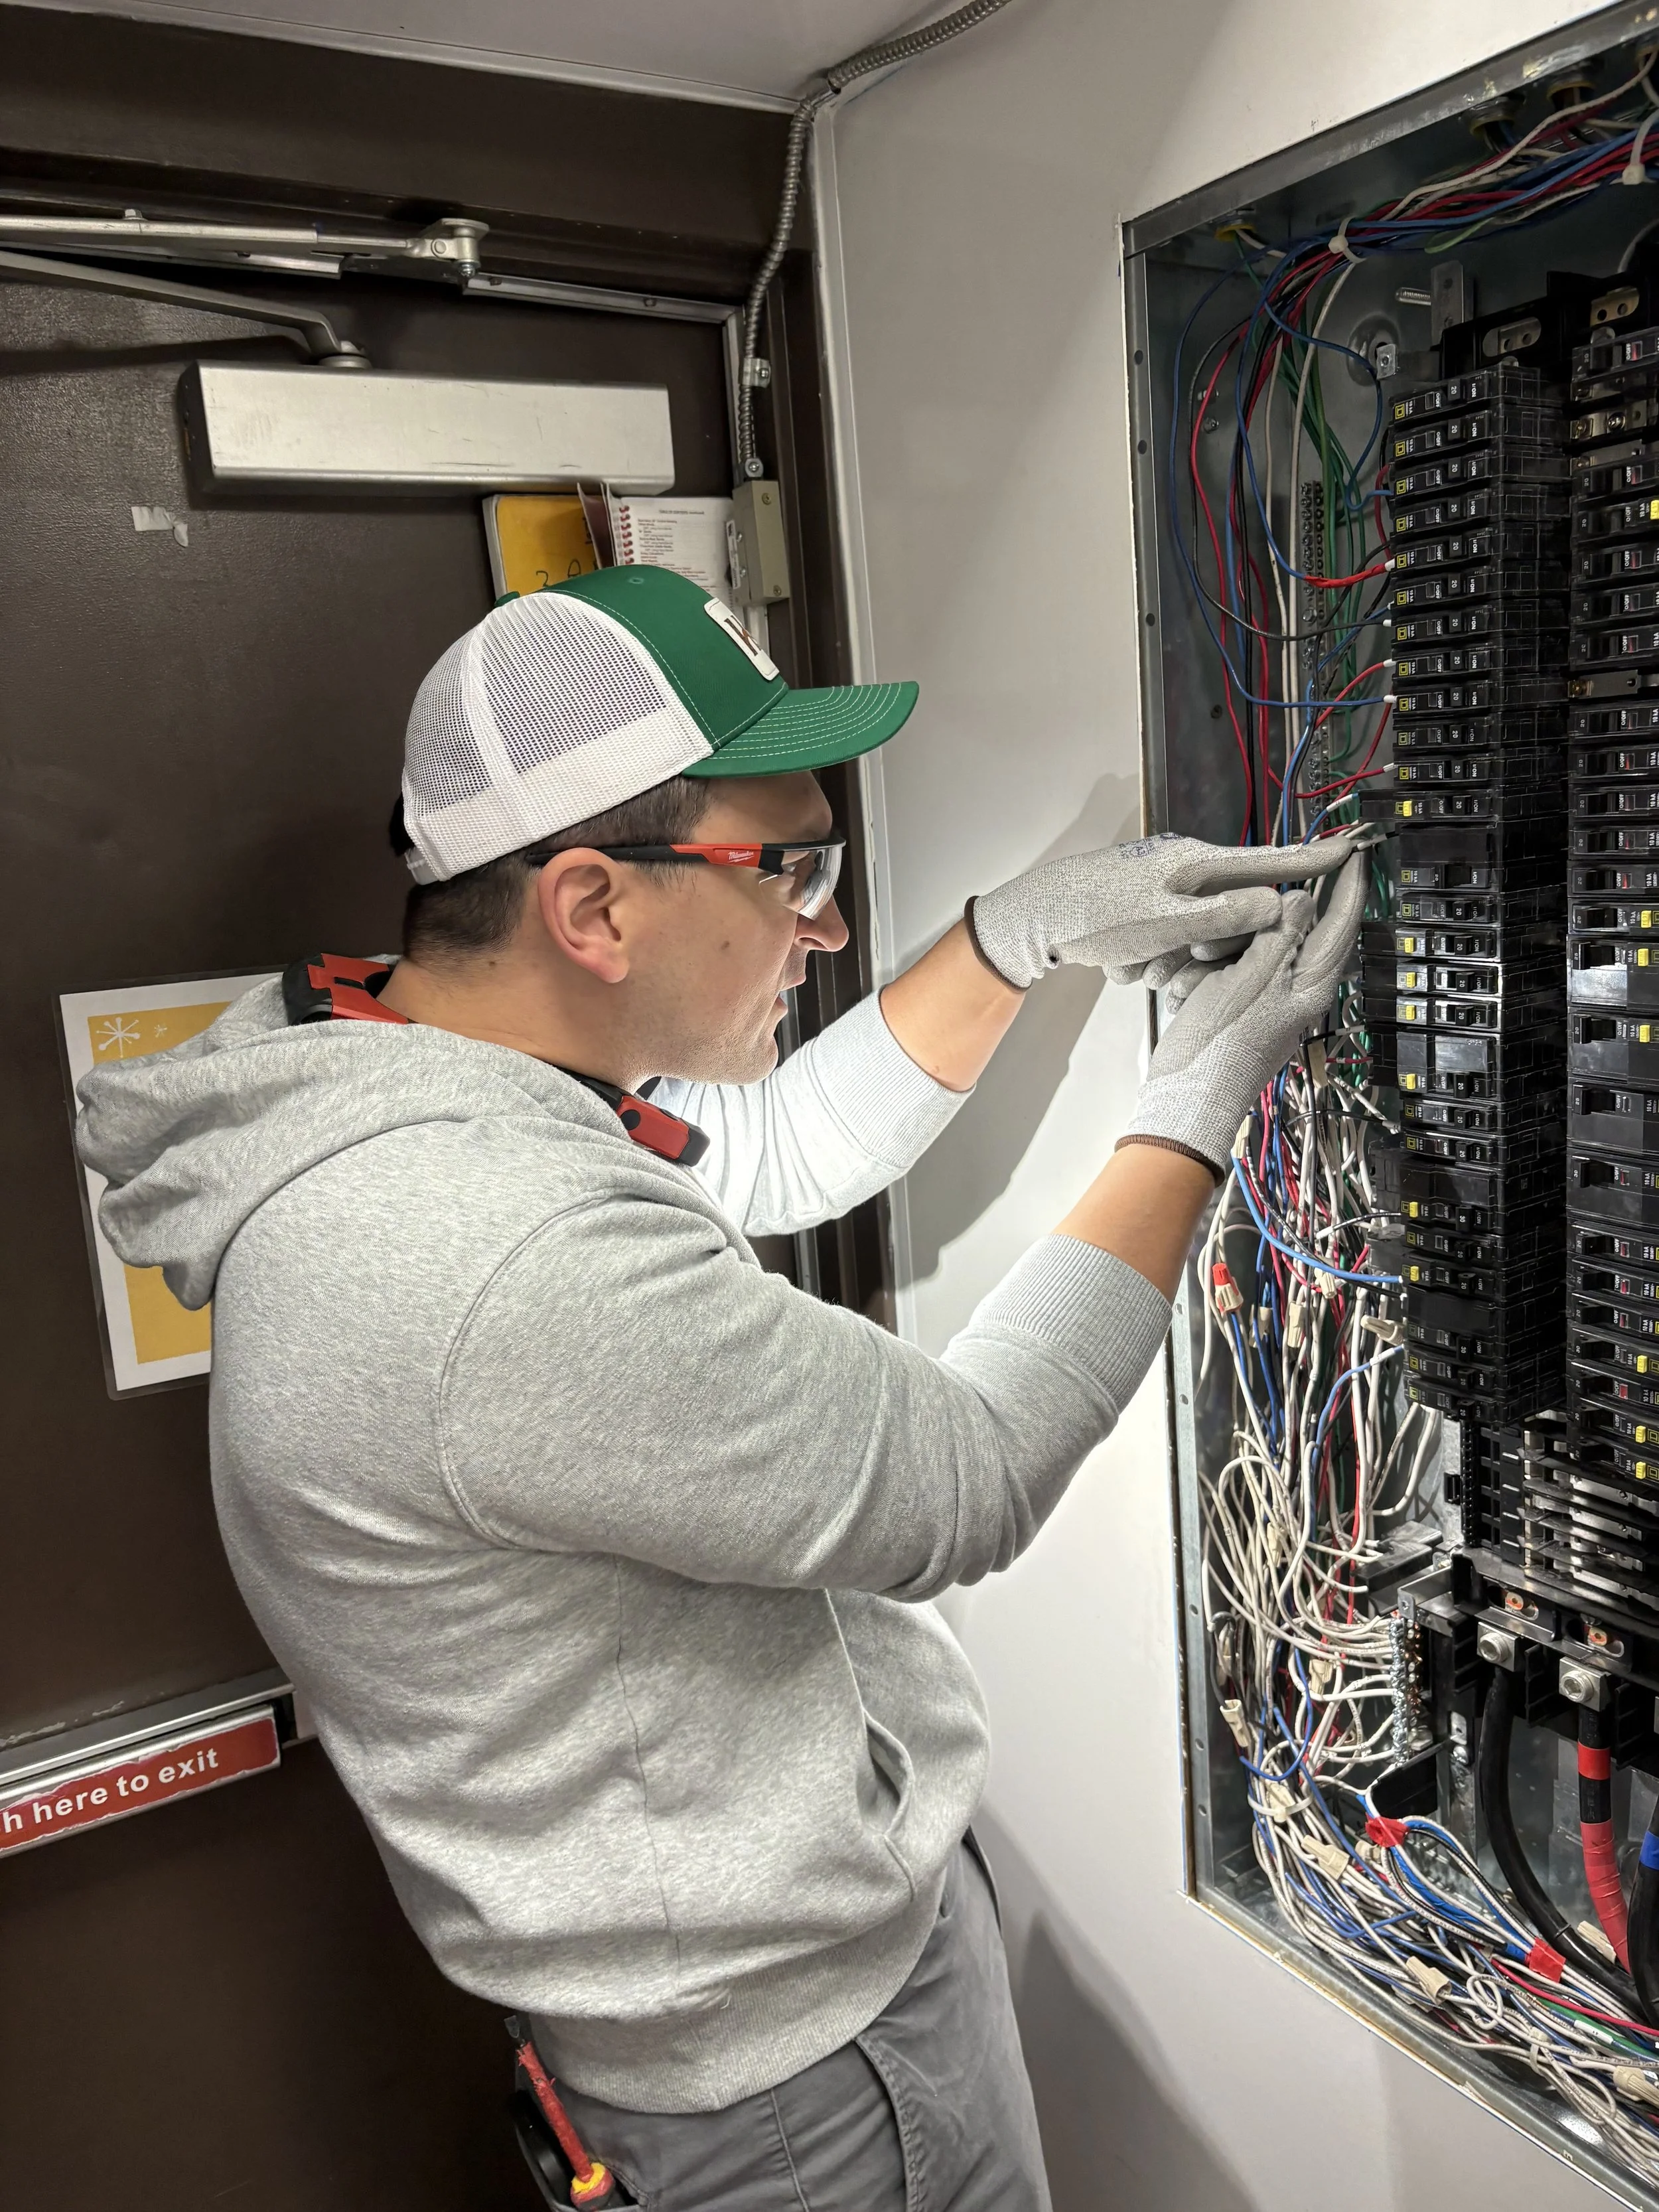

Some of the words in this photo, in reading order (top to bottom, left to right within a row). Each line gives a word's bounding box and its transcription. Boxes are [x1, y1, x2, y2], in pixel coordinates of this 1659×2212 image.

[1451, 386, 1457, 394] 20
[1452, 464, 1458, 473] 20
[0, 1810, 24, 1834] h
[33, 1787, 108, 1824] here
[116, 1774, 149, 1797] to
[158, 1748, 218, 1783] exit
